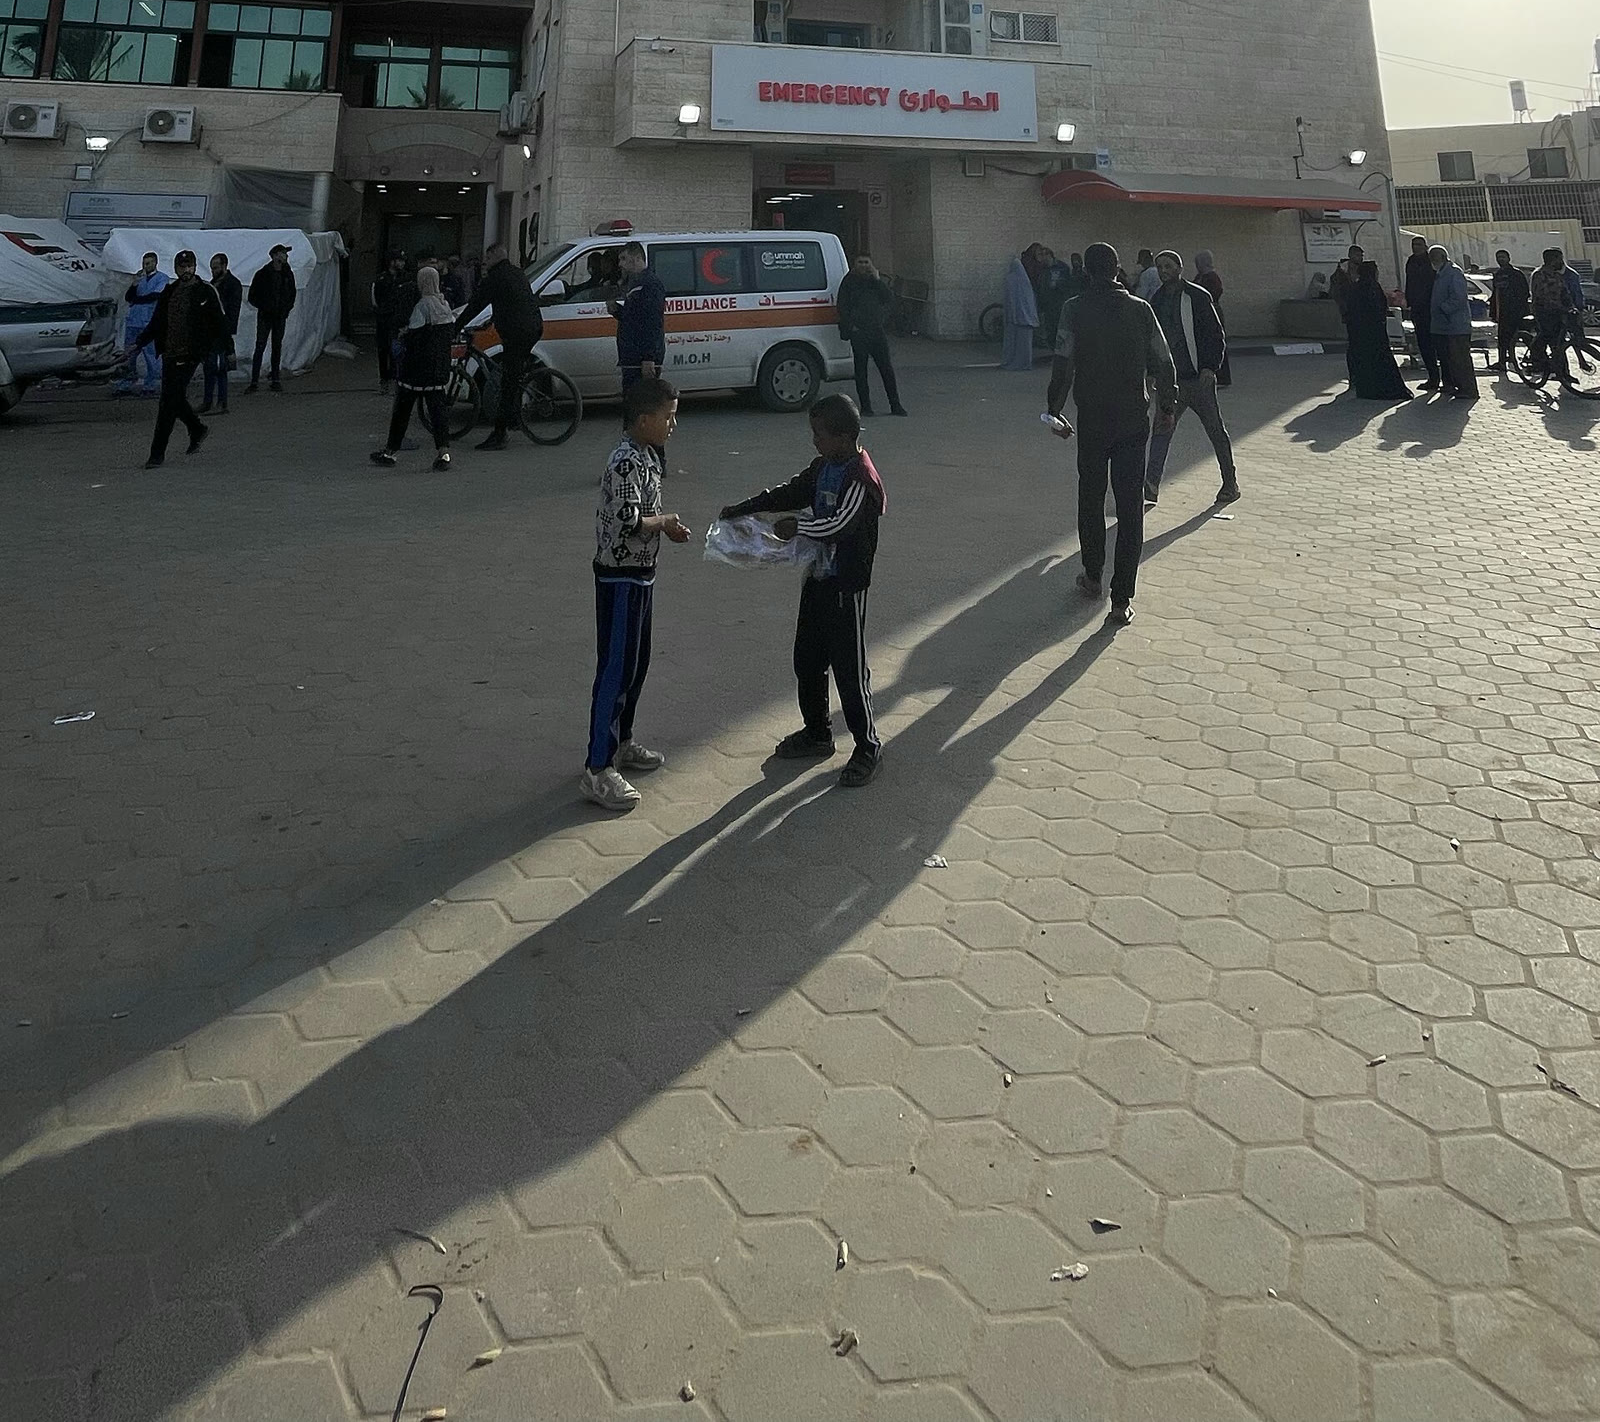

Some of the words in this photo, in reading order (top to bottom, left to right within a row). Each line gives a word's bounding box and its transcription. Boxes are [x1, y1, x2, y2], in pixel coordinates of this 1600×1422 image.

[758, 80, 890, 107] EMERGENCY
[774, 251, 805, 259] ummah
[663, 297, 737, 312] MBULANCE
